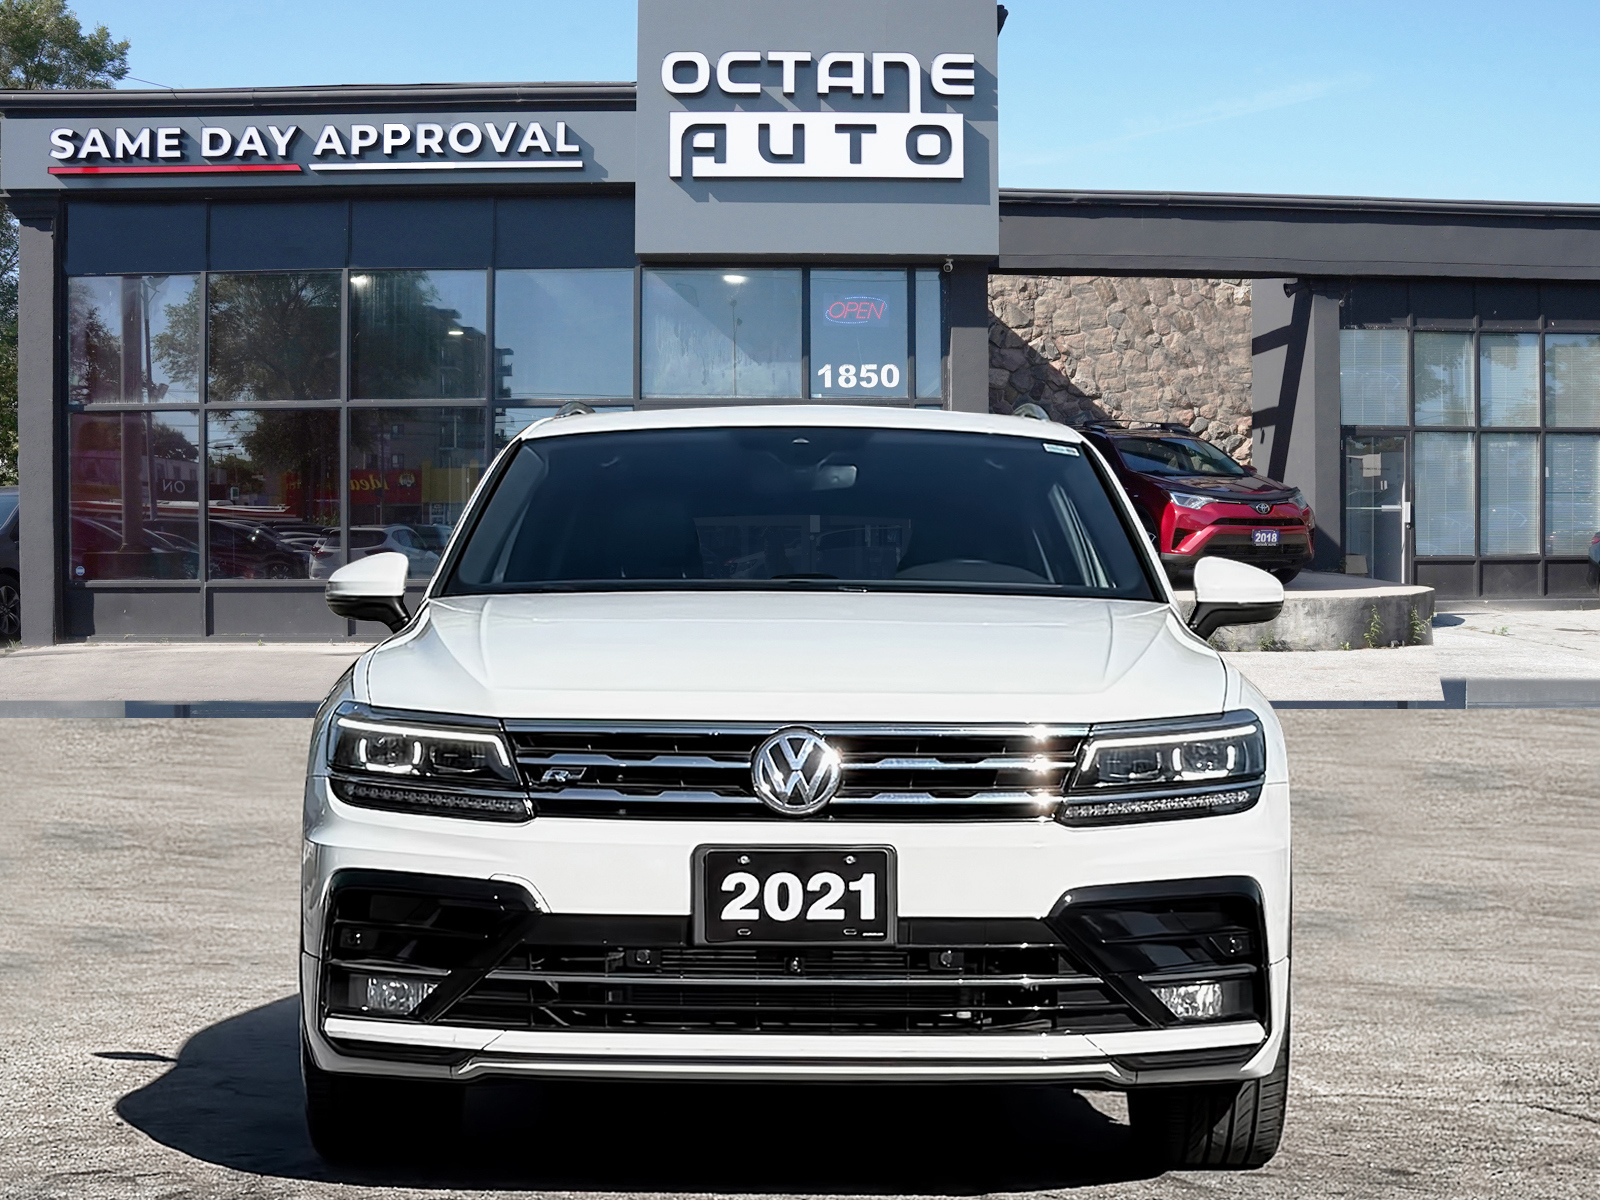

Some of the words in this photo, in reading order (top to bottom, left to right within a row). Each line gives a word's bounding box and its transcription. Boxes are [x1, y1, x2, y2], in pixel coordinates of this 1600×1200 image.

[661, 51, 975, 112] OCTANE
[50, 127, 181, 159] SAME
[200, 125, 298, 157] DAY
[312, 121, 580, 156] APPROVAL
[681, 123, 953, 177] AUTO
[828, 301, 885, 319] OPEN
[817, 363, 900, 388] 1850
[1255, 532, 1278, 543] 2018
[719, 870, 877, 922] 2021
